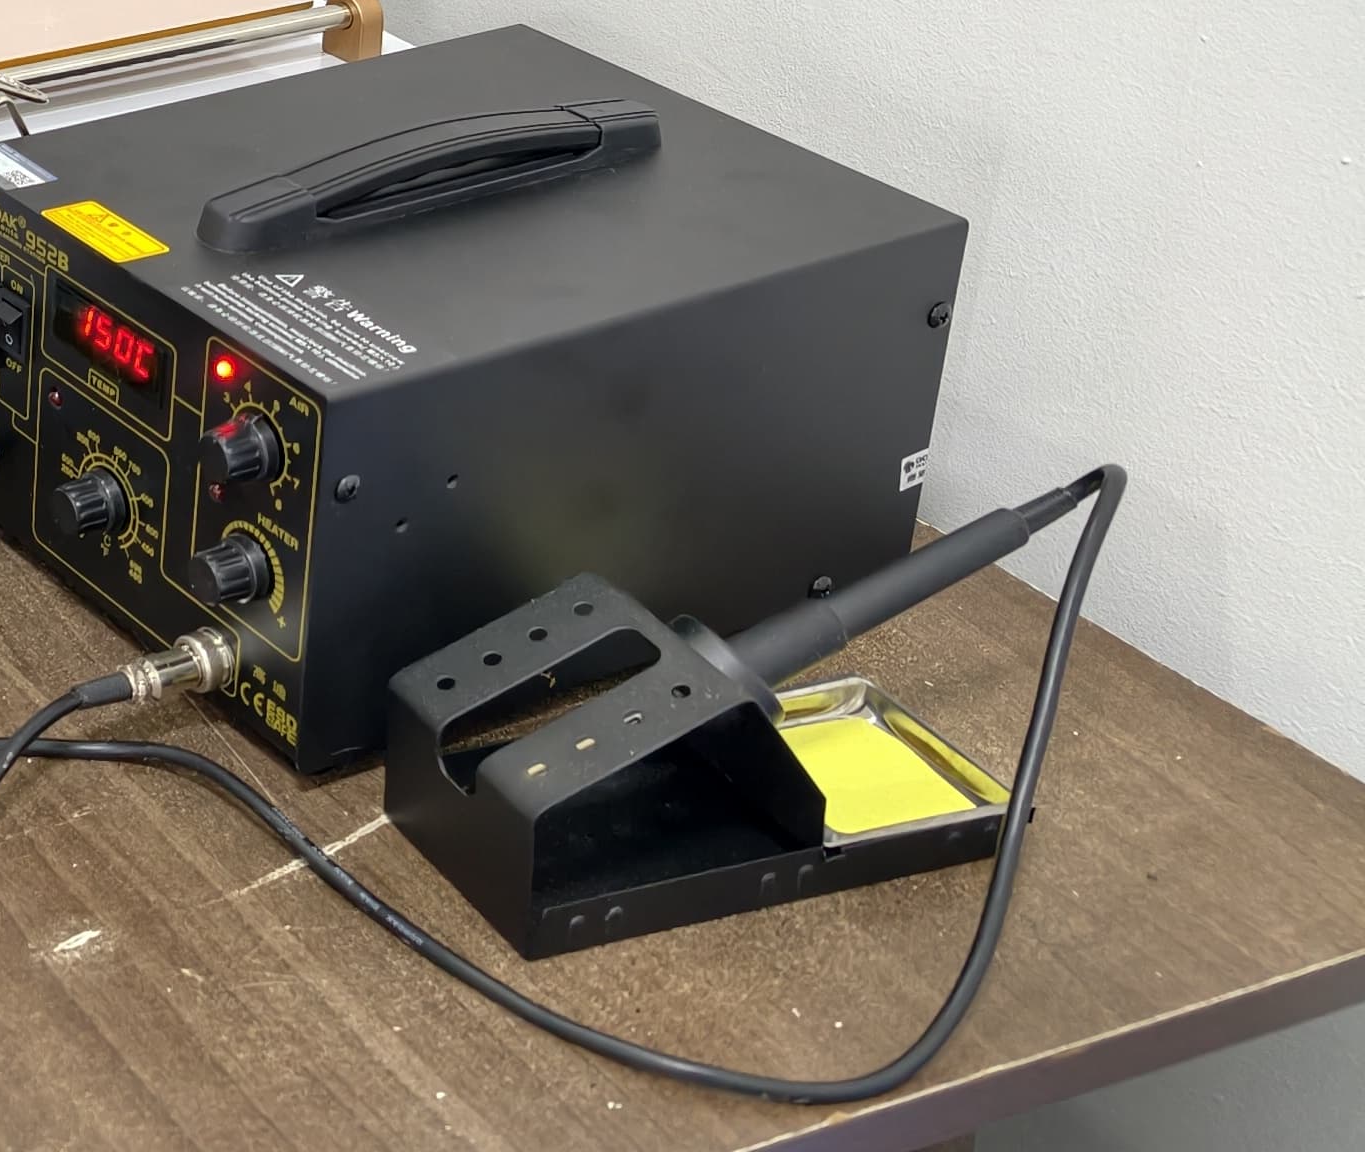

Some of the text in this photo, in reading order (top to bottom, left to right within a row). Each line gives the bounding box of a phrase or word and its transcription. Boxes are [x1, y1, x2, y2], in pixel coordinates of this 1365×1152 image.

[24, 229, 70, 272] 952B
[10, 279, 24, 295] ON
[346, 309, 418, 353] Warning
[5, 357, 22, 374] OFF
[91, 374, 117, 397] TEMP
[257, 512, 300, 552] HEATER
